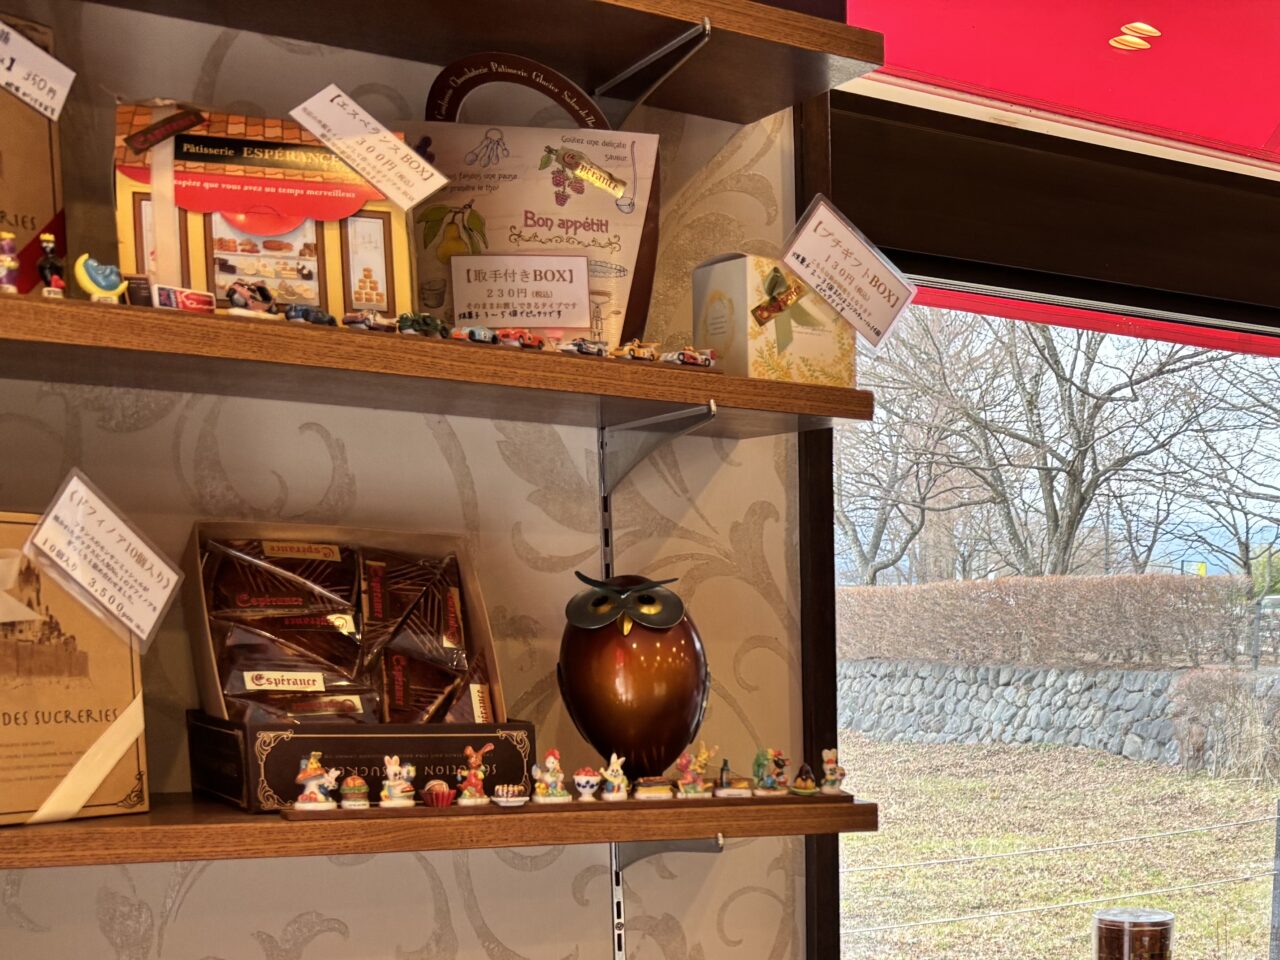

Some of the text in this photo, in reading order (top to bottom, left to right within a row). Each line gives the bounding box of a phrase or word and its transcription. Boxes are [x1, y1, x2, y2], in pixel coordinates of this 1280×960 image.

[182, 142, 235, 157] Pâtisserie
[203, 181, 219, 191] que
[221, 182, 242, 191] vous
[243, 184, 262, 193] avez
[264, 186, 277, 194] un
[278, 186, 304, 198] temps
[523, 210, 554, 231] Bon
[465, 268, 575, 284] 【取手付きBOX】
[486, 287, 528, 299] 230円
[250, 672, 318, 689] Espérance
[2, 708, 118, 726] DES SUCRERIES
